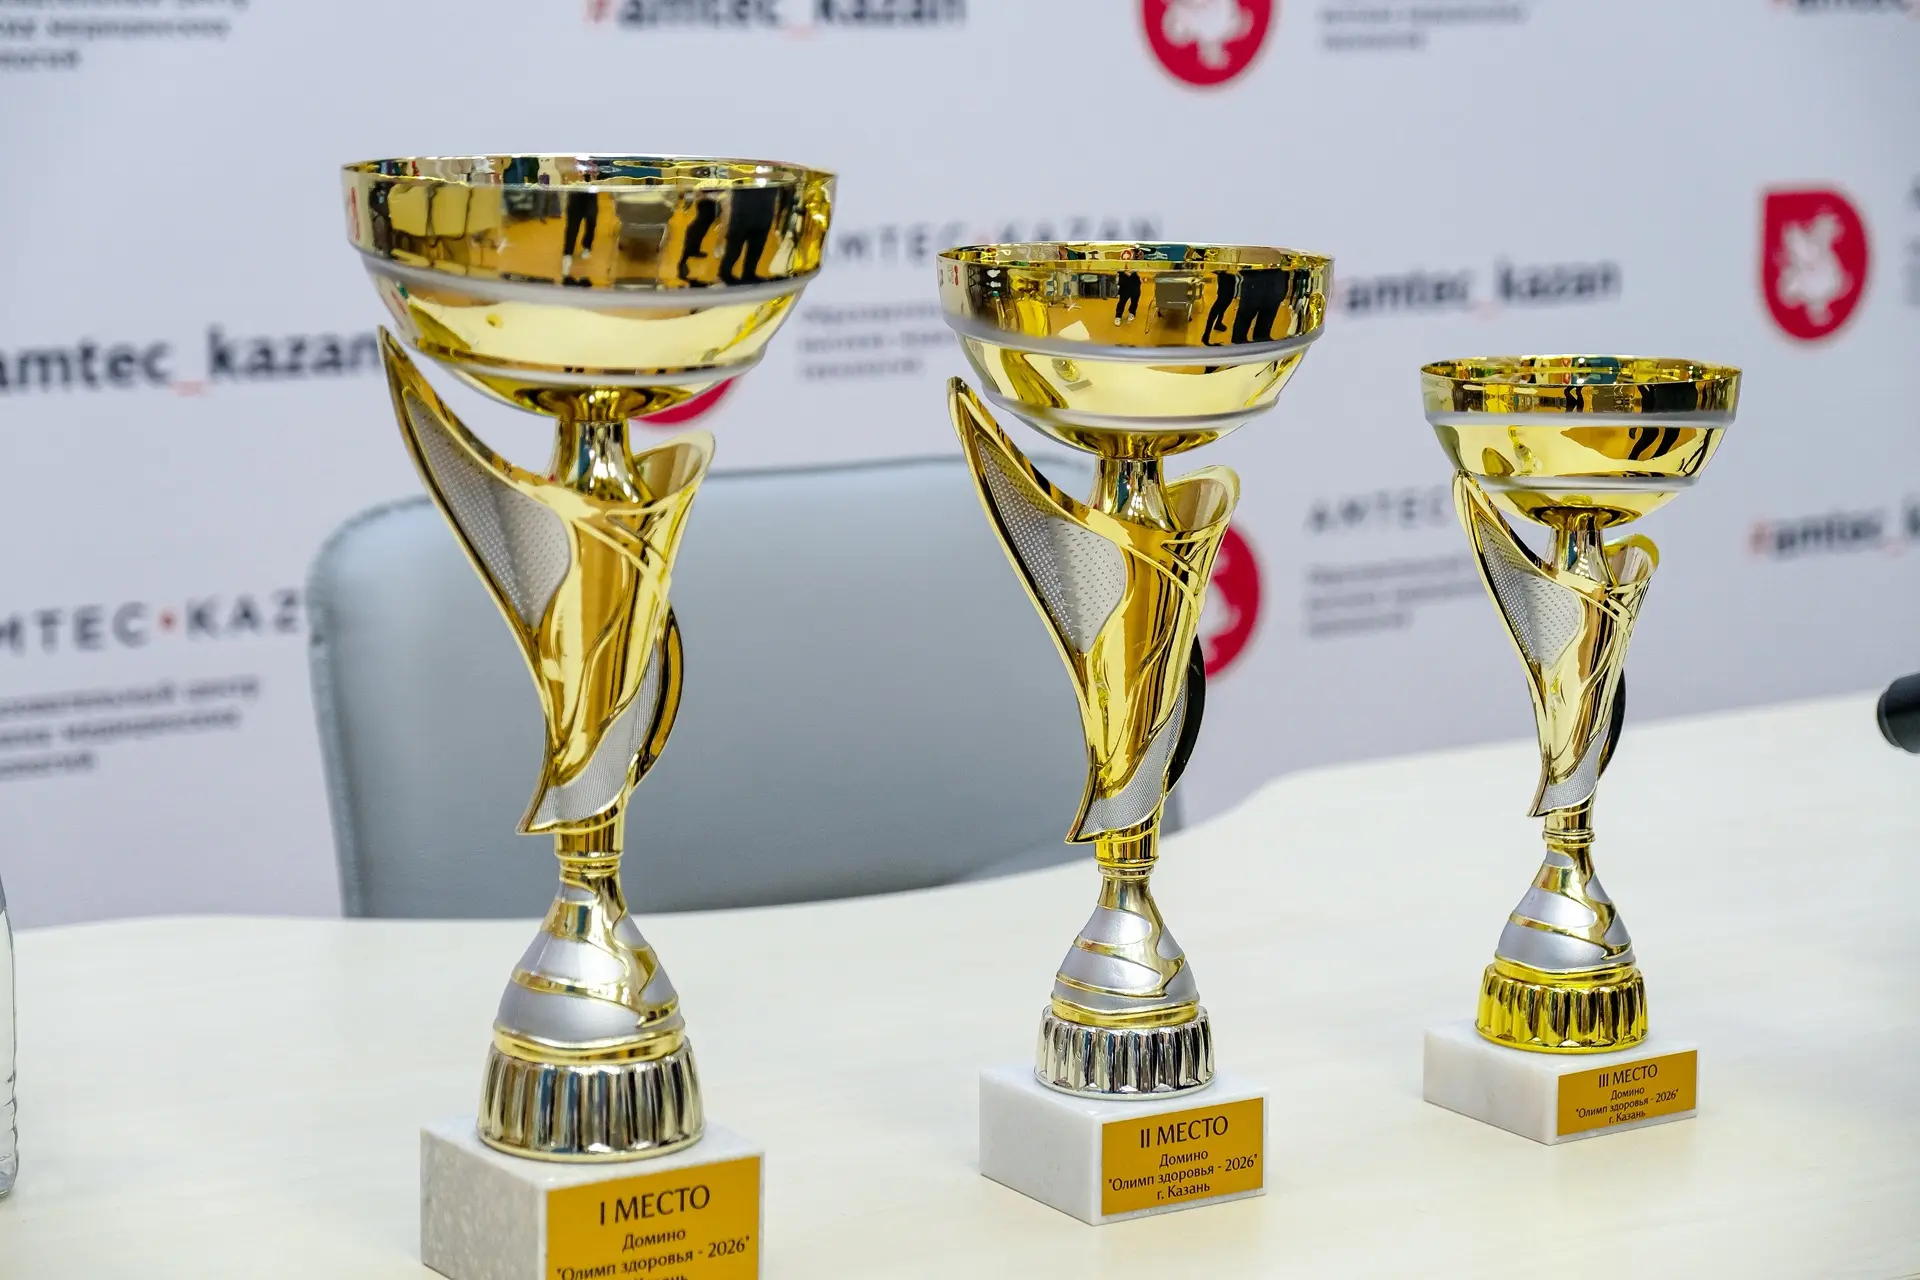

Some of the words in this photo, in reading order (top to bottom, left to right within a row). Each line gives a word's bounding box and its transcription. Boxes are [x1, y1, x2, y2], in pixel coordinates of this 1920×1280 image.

[0, 326, 379, 397] mtec_kazan
[1598, 1073, 1609, 1088] III
[1612, 1063, 1658, 1085] МЕСТО
[1575, 1104, 1608, 1119] "Олимп
[1609, 1096, 1649, 1113] здоровья
[1655, 1088, 1679, 1103] 2026"
[1610, 1086, 1645, 1101] Домино
[1608, 1116, 1614, 1124] г.
[1616, 1109, 1646, 1122] Казань
[1140, 1128, 1150, 1148] II
[1157, 1115, 1229, 1146] МЕСТО
[1108, 1175, 1155, 1191] "Олимп
[1158, 1164, 1214, 1184] здоровья
[1225, 1153, 1258, 1172] 2026"
[1159, 1150, 1209, 1169] Домино
[599, 1201, 606, 1226] I
[614, 1184, 711, 1224] МЕСТО
[1157, 1191, 1165, 1200] г.
[1168, 1182, 1210, 1199] Казань
[622, 1228, 687, 1253] Домино
[556, 1264, 616, 1280] "Олимп
[621, 1249, 693, 1273] здоровья
[708, 1235, 750, 1258] 2026"
